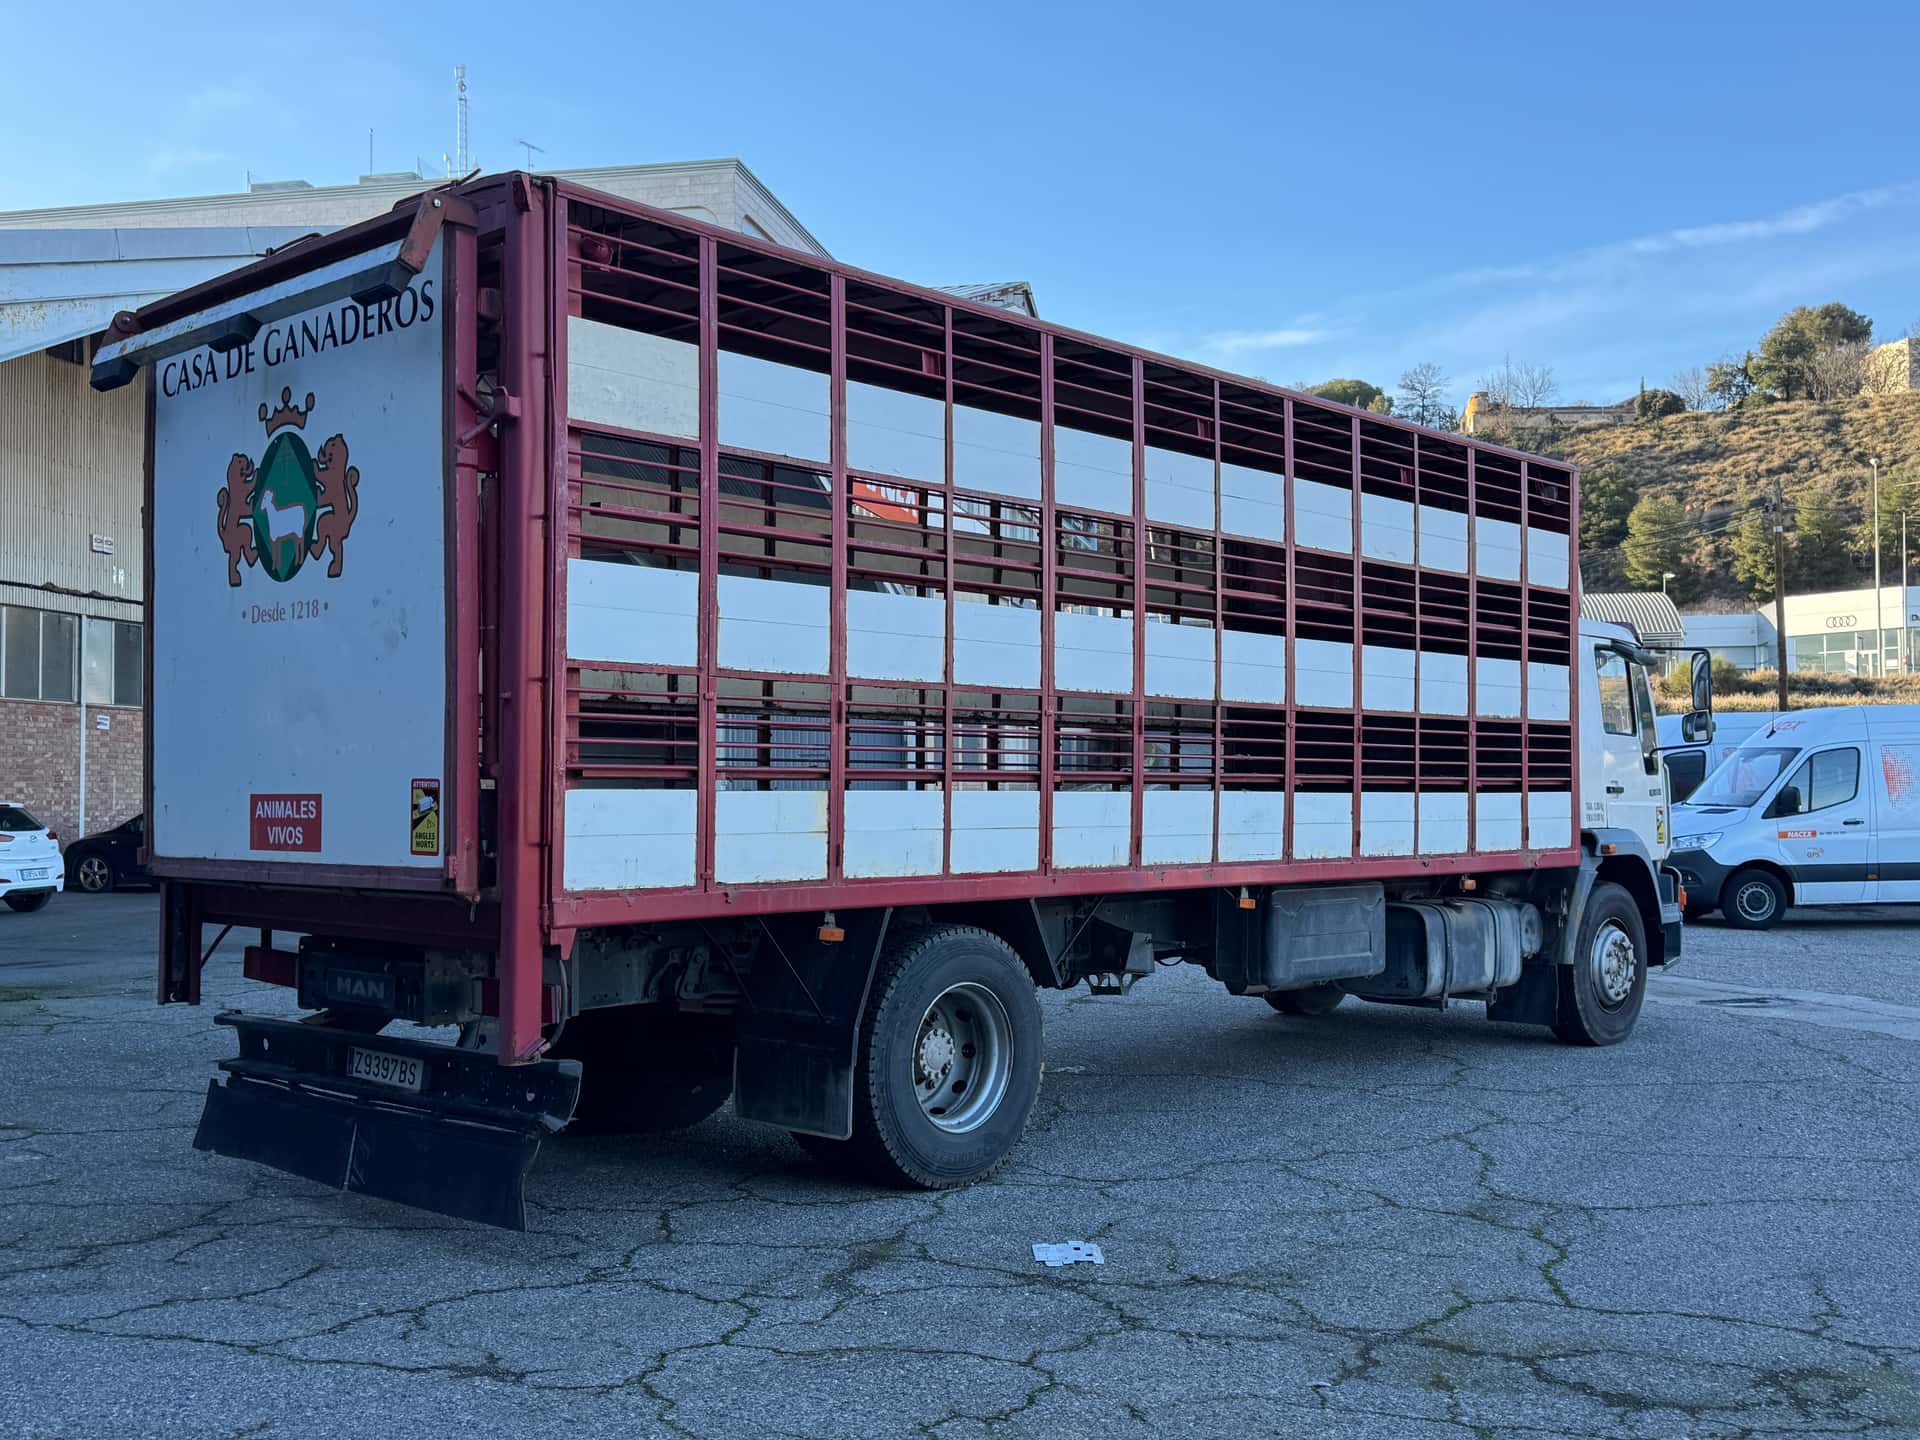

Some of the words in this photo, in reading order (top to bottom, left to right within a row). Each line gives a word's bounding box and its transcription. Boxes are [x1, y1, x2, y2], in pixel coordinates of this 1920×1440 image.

[162, 350, 218, 397] CASA
[226, 342, 255, 379] DE
[263, 280, 434, 367] GANADEROS
[251, 601, 286, 624] Desde
[291, 599, 319, 619] 1218
[256, 800, 316, 819] ANIMALES
[267, 826, 303, 845] VIVOS
[415, 832, 435, 840] ANGLES
[416, 840, 434, 848] MORTS
[337, 976, 385, 999] MAN
[355, 1051, 417, 1085] Z9397BS
